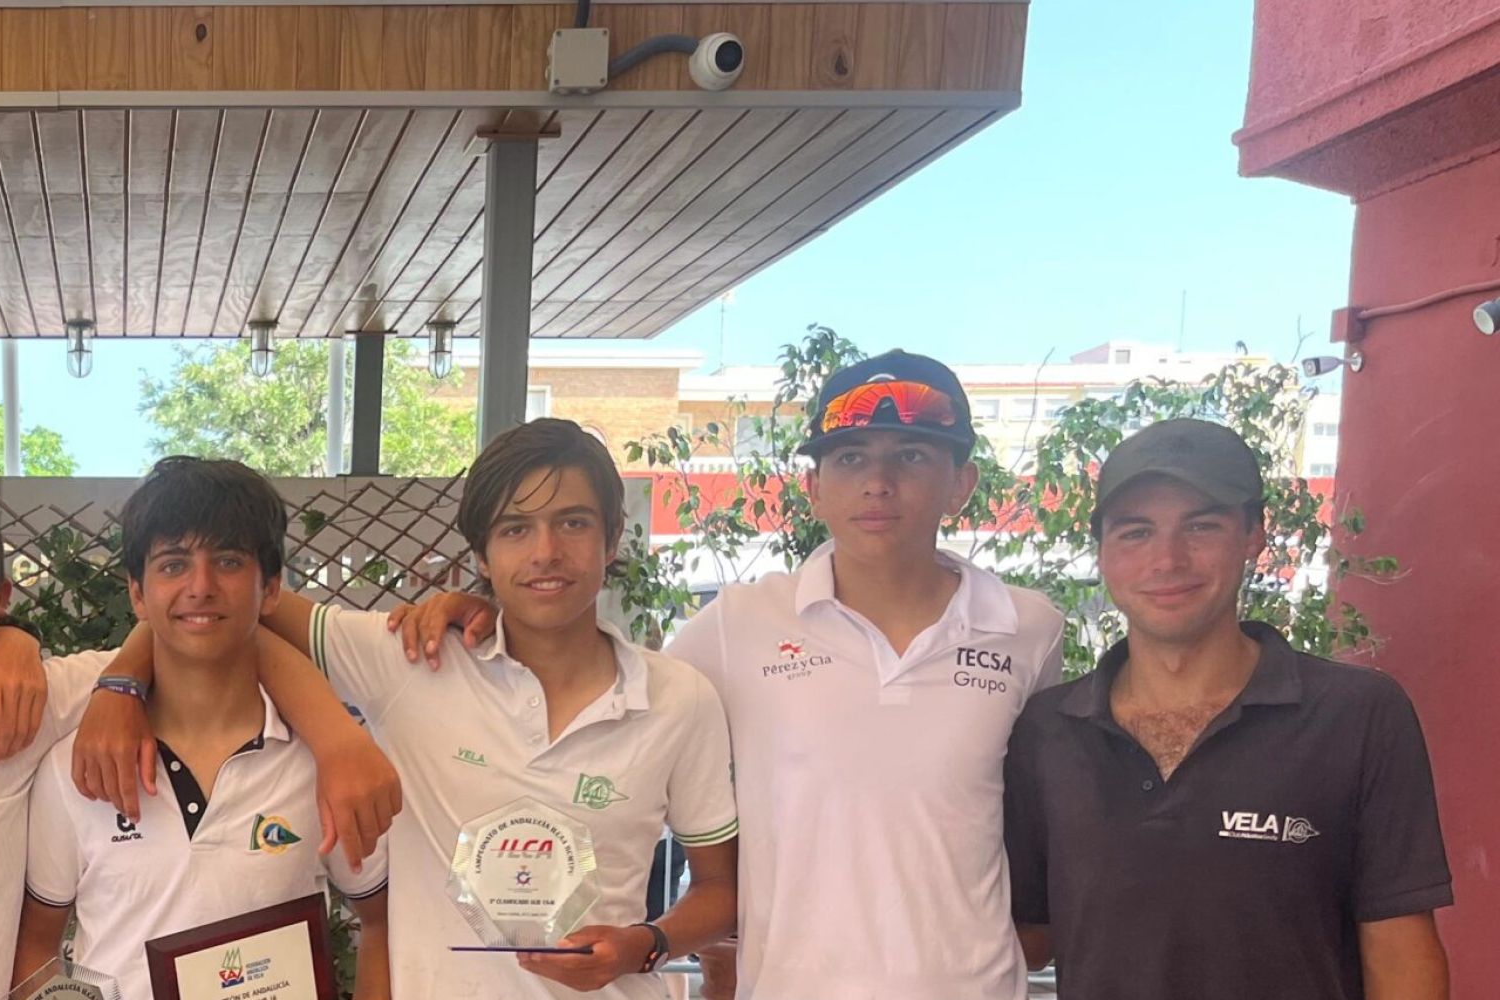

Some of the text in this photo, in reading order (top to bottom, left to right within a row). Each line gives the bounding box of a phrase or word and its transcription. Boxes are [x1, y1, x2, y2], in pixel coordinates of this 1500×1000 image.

[800, 660, 807, 671] y
[957, 647, 1012, 675] TECSA
[954, 671, 1007, 696] Grupo
[458, 747, 485, 763] VELA
[498, 822, 508, 831] DE
[1222, 811, 1279, 834] VELA
[497, 839, 553, 859] ILCA
[242, 991, 251, 1000] DE
[251, 980, 291, 997] ANDALUCÍA
